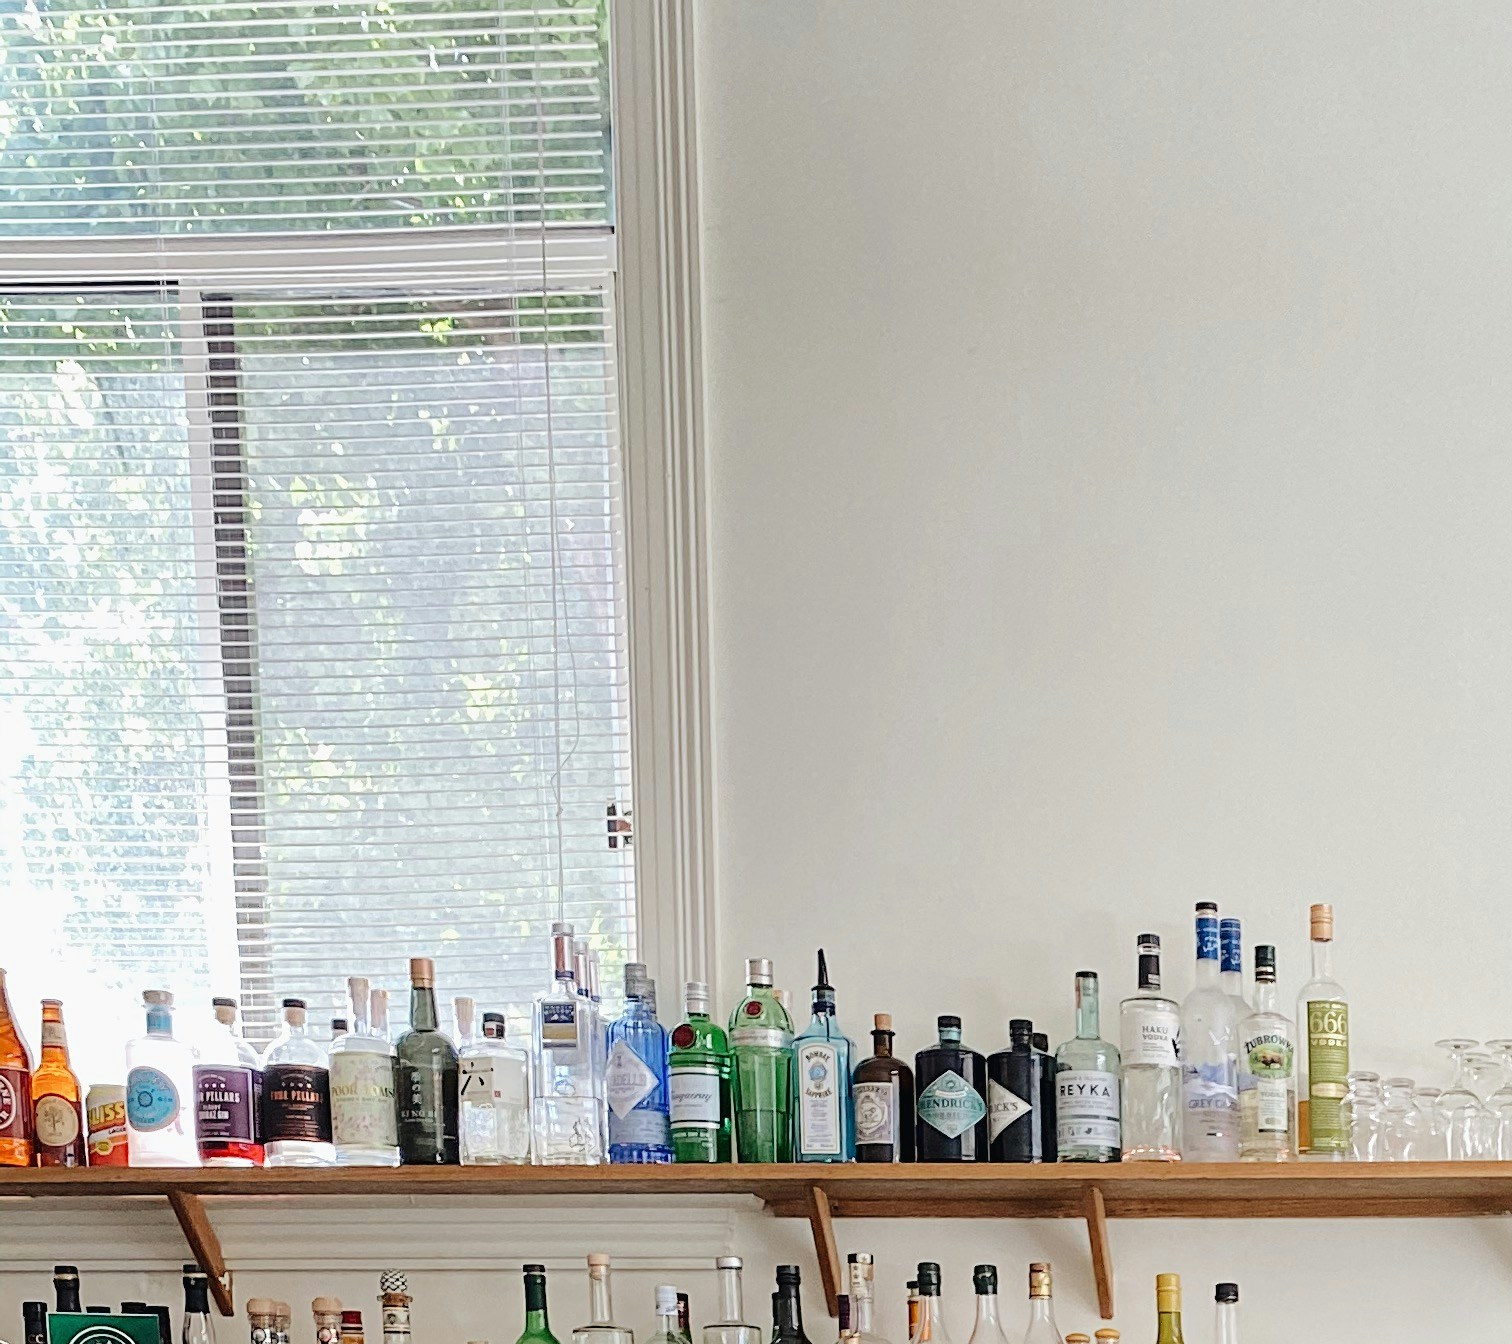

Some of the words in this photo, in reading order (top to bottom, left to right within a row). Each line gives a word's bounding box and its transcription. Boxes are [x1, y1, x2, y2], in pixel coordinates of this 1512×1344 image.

[1309, 1011, 1347, 1035] 666
[1142, 1025, 1169, 1035] HAKU
[805, 1050, 831, 1062] BOMBAY
[1060, 1083, 1111, 1098] REYKA
[206, 1091, 240, 1103] PILLARS
